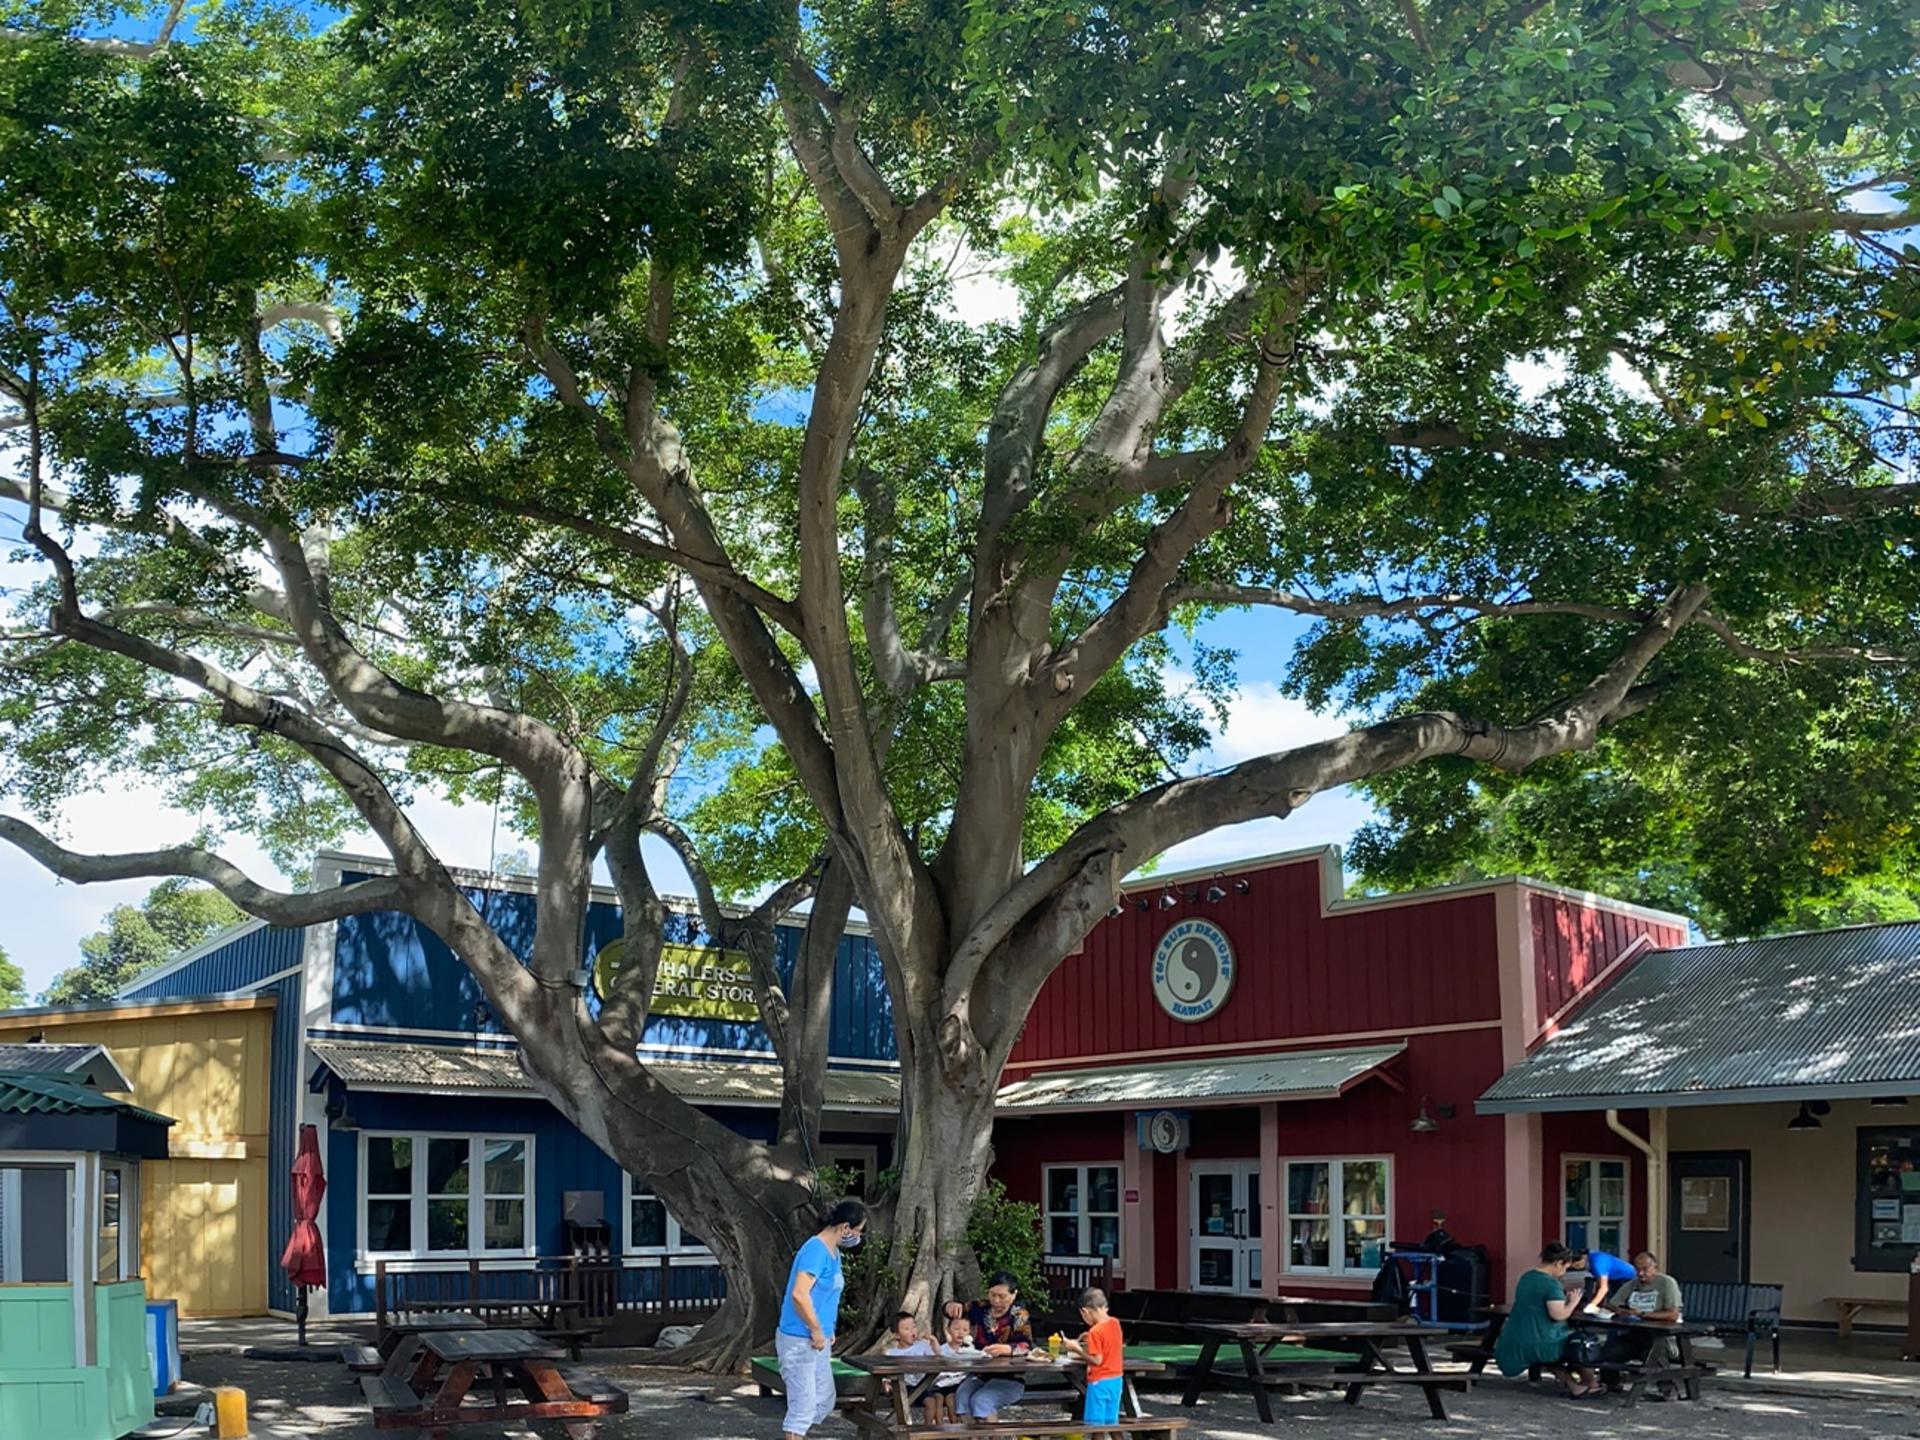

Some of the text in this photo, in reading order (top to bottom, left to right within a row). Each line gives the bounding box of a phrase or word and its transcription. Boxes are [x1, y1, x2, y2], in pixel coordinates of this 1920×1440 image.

[1163, 923, 1192, 949] SURF
[1195, 923, 1230, 977] DESIGNS
[706, 984, 757, 1004] STOR
[1172, 999, 1213, 1015] HAWAII
